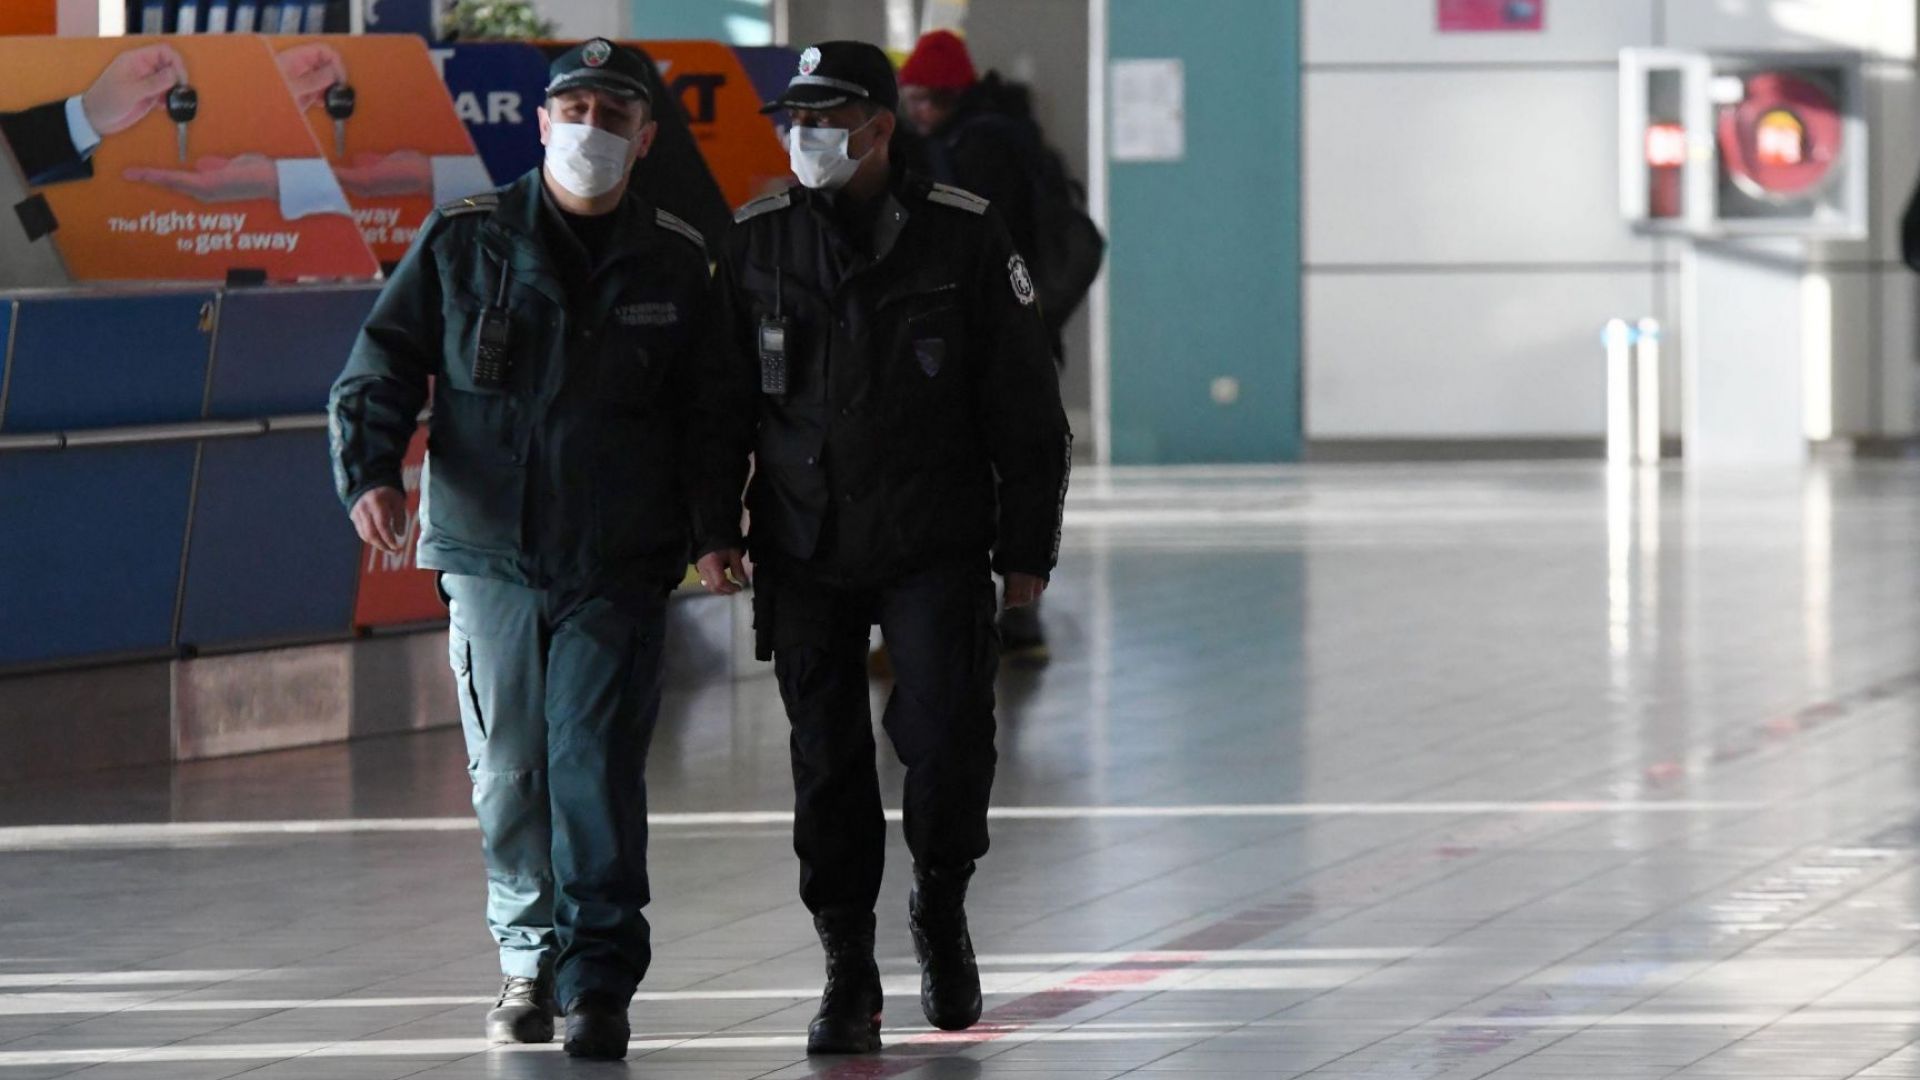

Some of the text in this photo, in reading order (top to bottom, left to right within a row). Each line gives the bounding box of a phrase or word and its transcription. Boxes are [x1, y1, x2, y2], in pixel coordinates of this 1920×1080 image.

[108, 210, 247, 236] The right way
[177, 231, 300, 254] to get away
